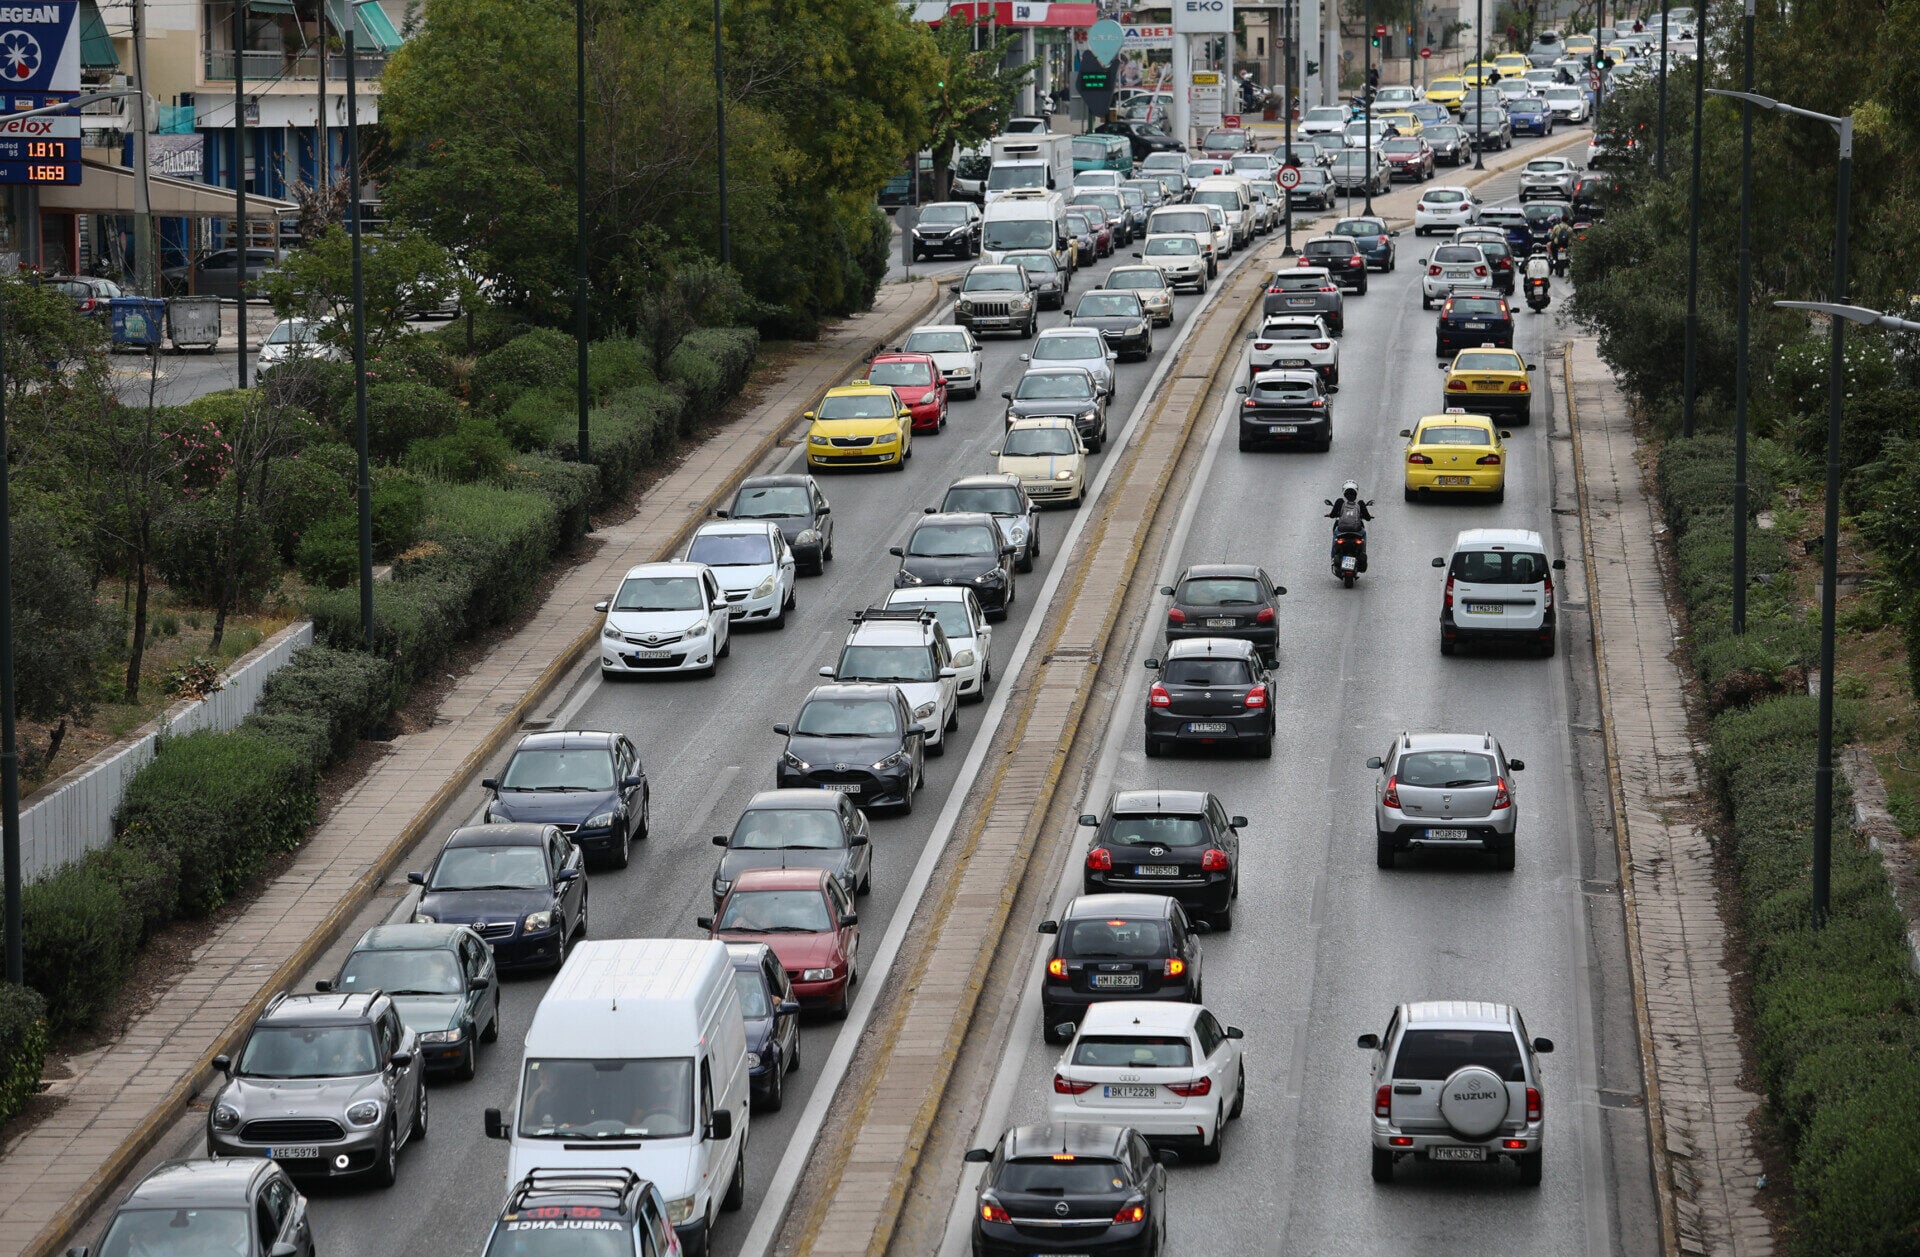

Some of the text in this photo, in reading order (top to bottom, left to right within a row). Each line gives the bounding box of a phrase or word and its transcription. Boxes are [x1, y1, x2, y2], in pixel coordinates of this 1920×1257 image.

[1186, 1, 1223, 11] EKO
[0, 5, 59, 23] EGEAN
[28, 142, 64, 157] 1.817
[28, 165, 64, 180] 1.669
[1282, 172, 1296, 182] 60
[1117, 976, 1139, 985] 8270
[1132, 1087, 1155, 1097] 2228
[1454, 1091, 1497, 1101] SUZUKI
[294, 1148, 317, 1158] 5978
